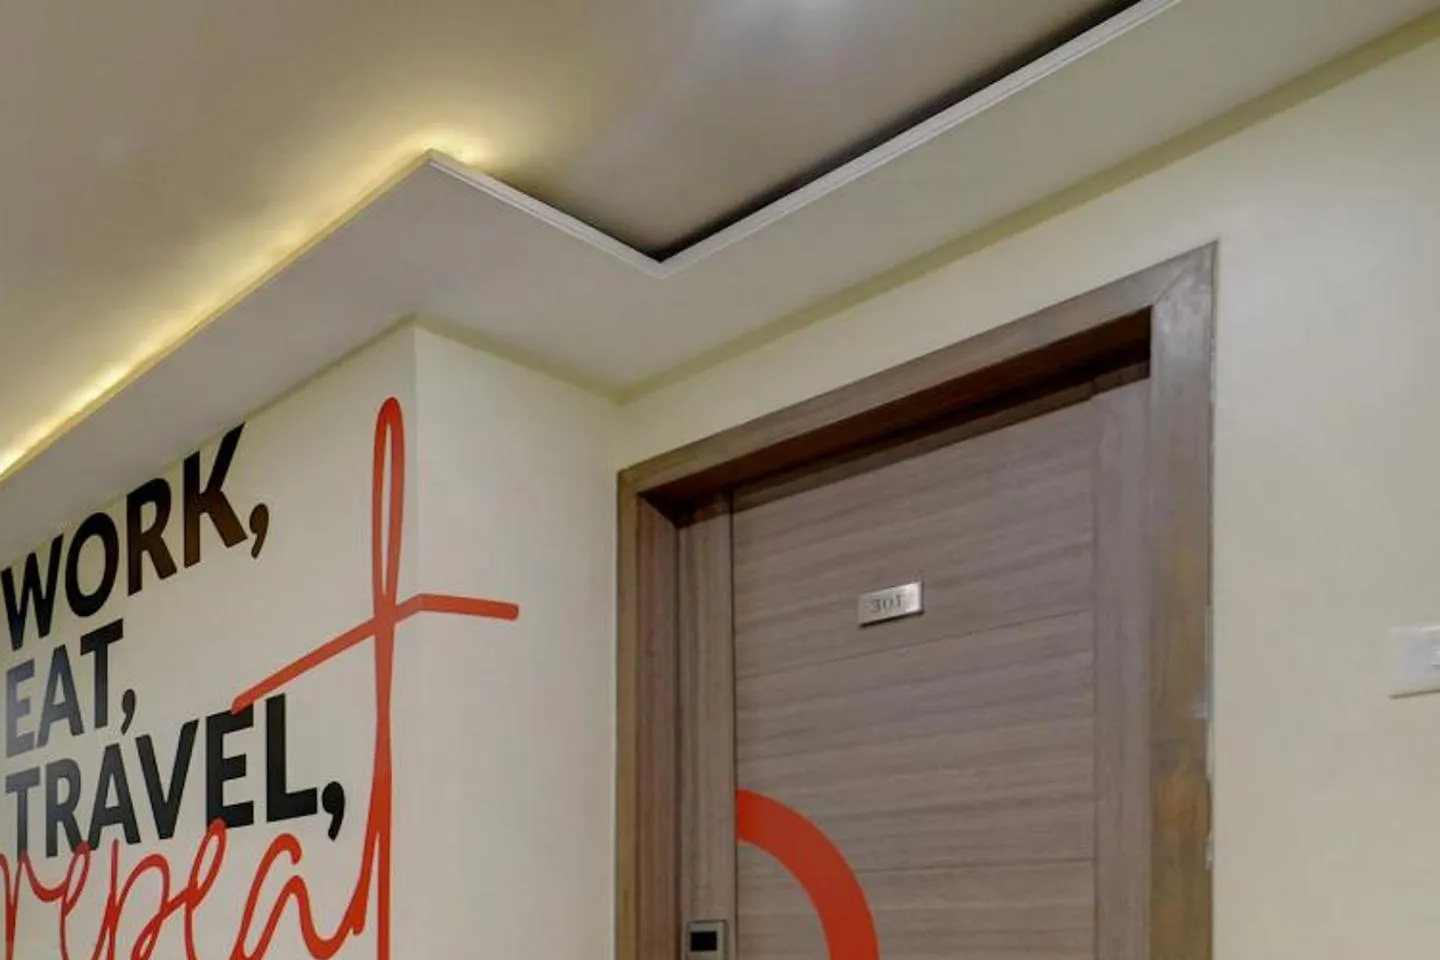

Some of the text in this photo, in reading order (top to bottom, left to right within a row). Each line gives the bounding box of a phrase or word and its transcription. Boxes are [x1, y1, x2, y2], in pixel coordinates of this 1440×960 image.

[0, 423, 270, 651] WORK,
[4, 620, 137, 758] EAT,
[4, 693, 347, 862] TRAVEL,
